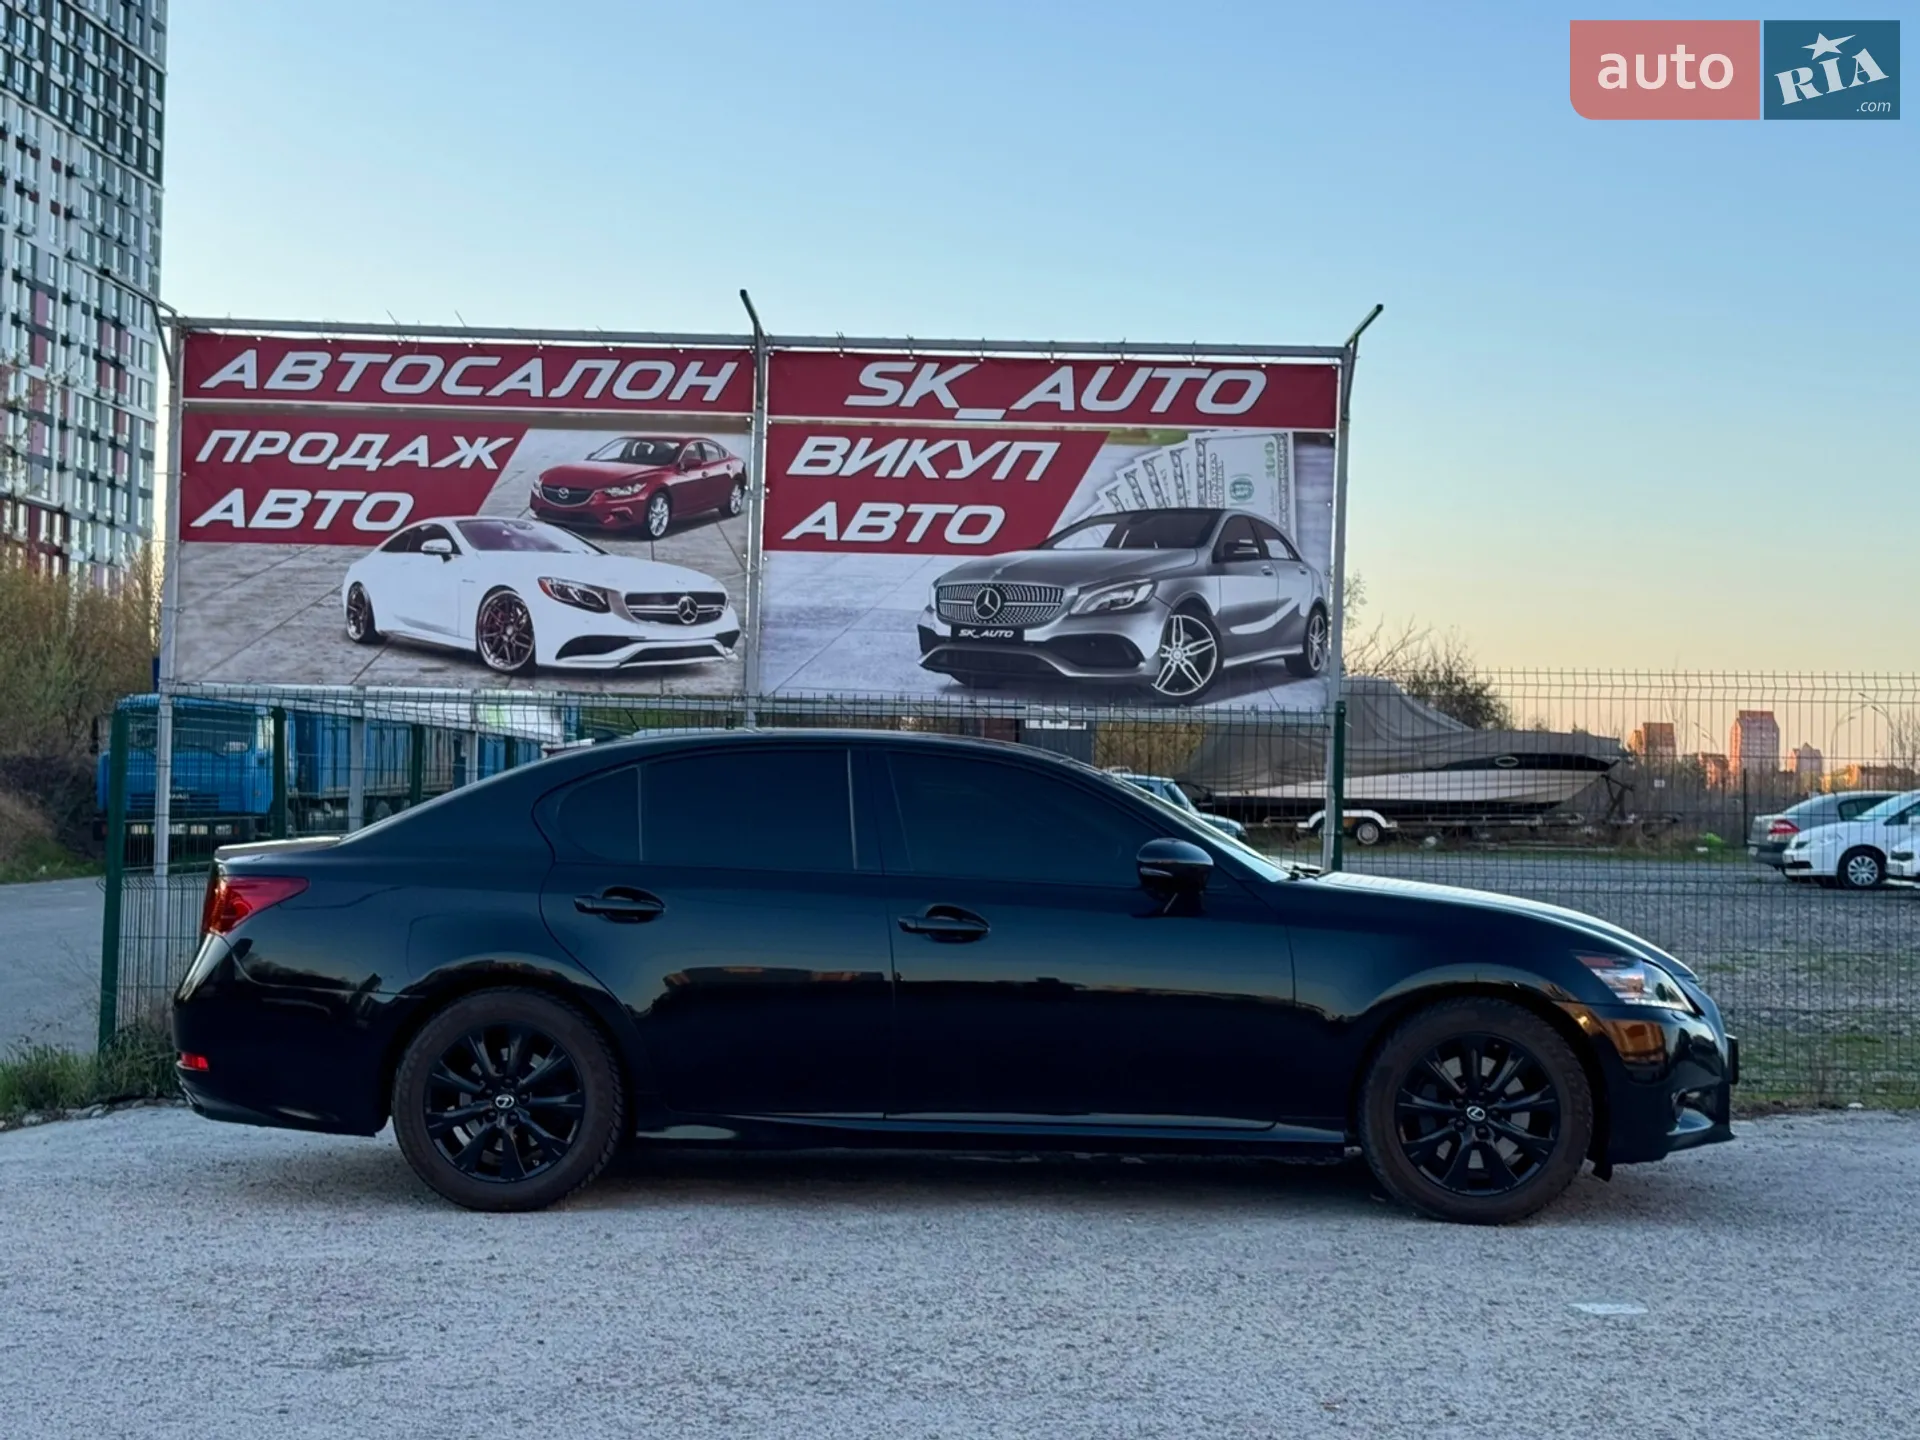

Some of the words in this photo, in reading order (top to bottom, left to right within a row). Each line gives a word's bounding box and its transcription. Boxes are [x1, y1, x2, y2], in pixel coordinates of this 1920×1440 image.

[200, 349, 739, 402] АВТОСАЛОН
[844, 360, 1267, 420] SK_AUTO
[195, 429, 514, 472] ПРОДАЖ
[786, 435, 1061, 482] ВИКУП
[190, 487, 415, 532] АВТО
[781, 501, 1006, 544] АВТО
[958, 628, 1015, 639] SK_AUTO
